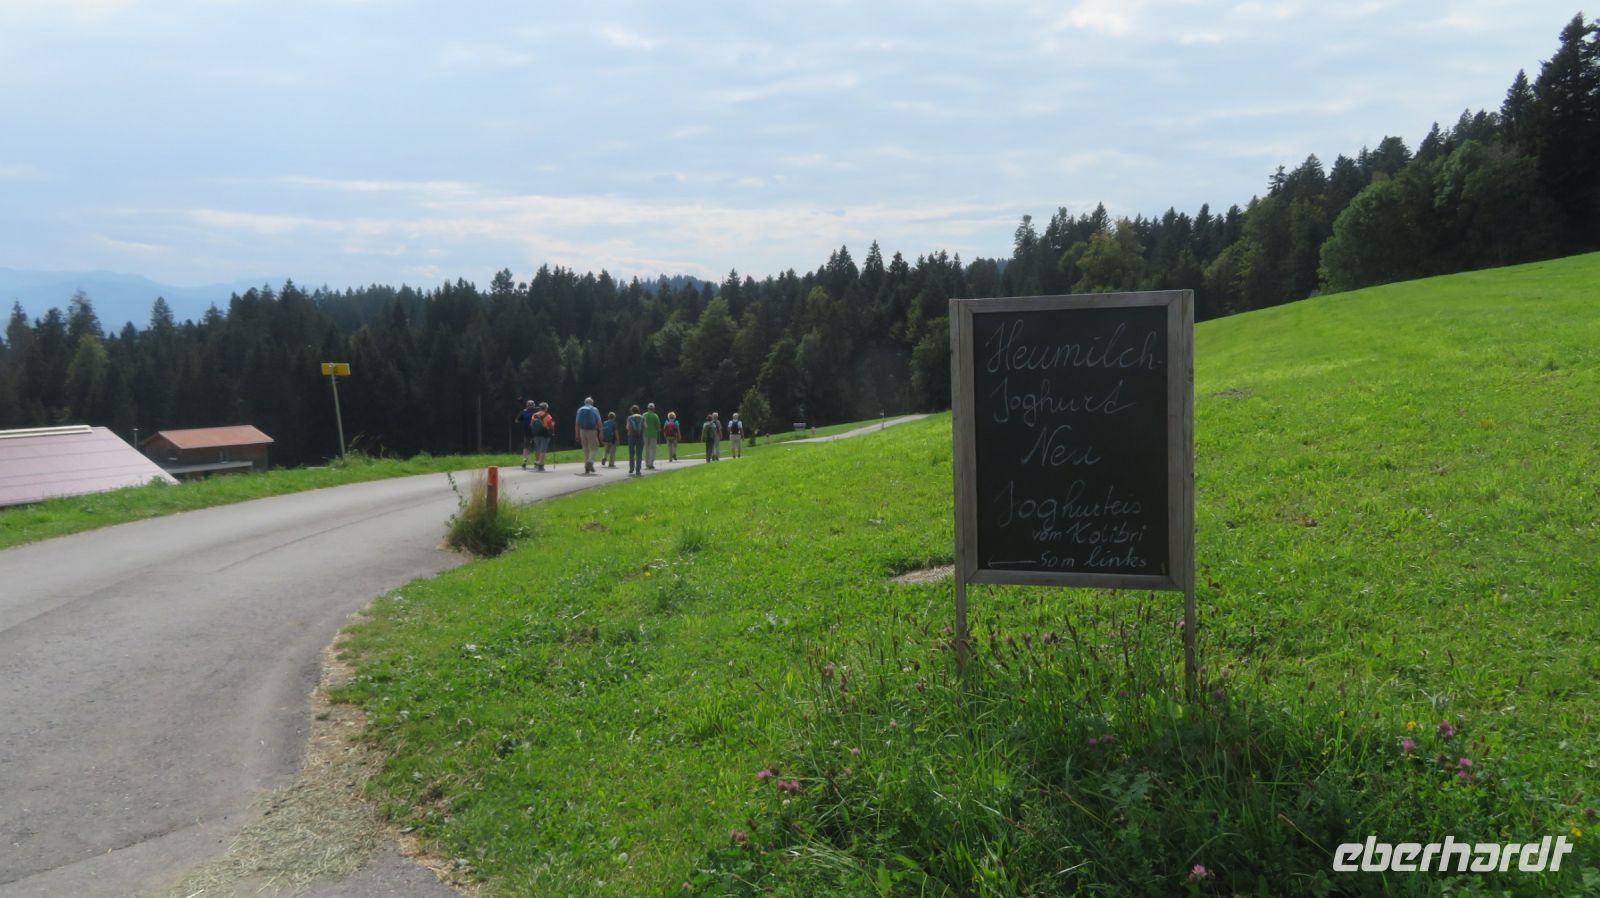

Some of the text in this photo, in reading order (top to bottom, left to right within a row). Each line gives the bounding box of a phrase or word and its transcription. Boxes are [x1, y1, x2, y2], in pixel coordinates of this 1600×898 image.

[1020, 424, 1101, 467] Neu
[994, 479, 1142, 531] Joghurteis
[1033, 521, 1147, 545] vom Kolibri
[1083, 546, 1148, 569] links
